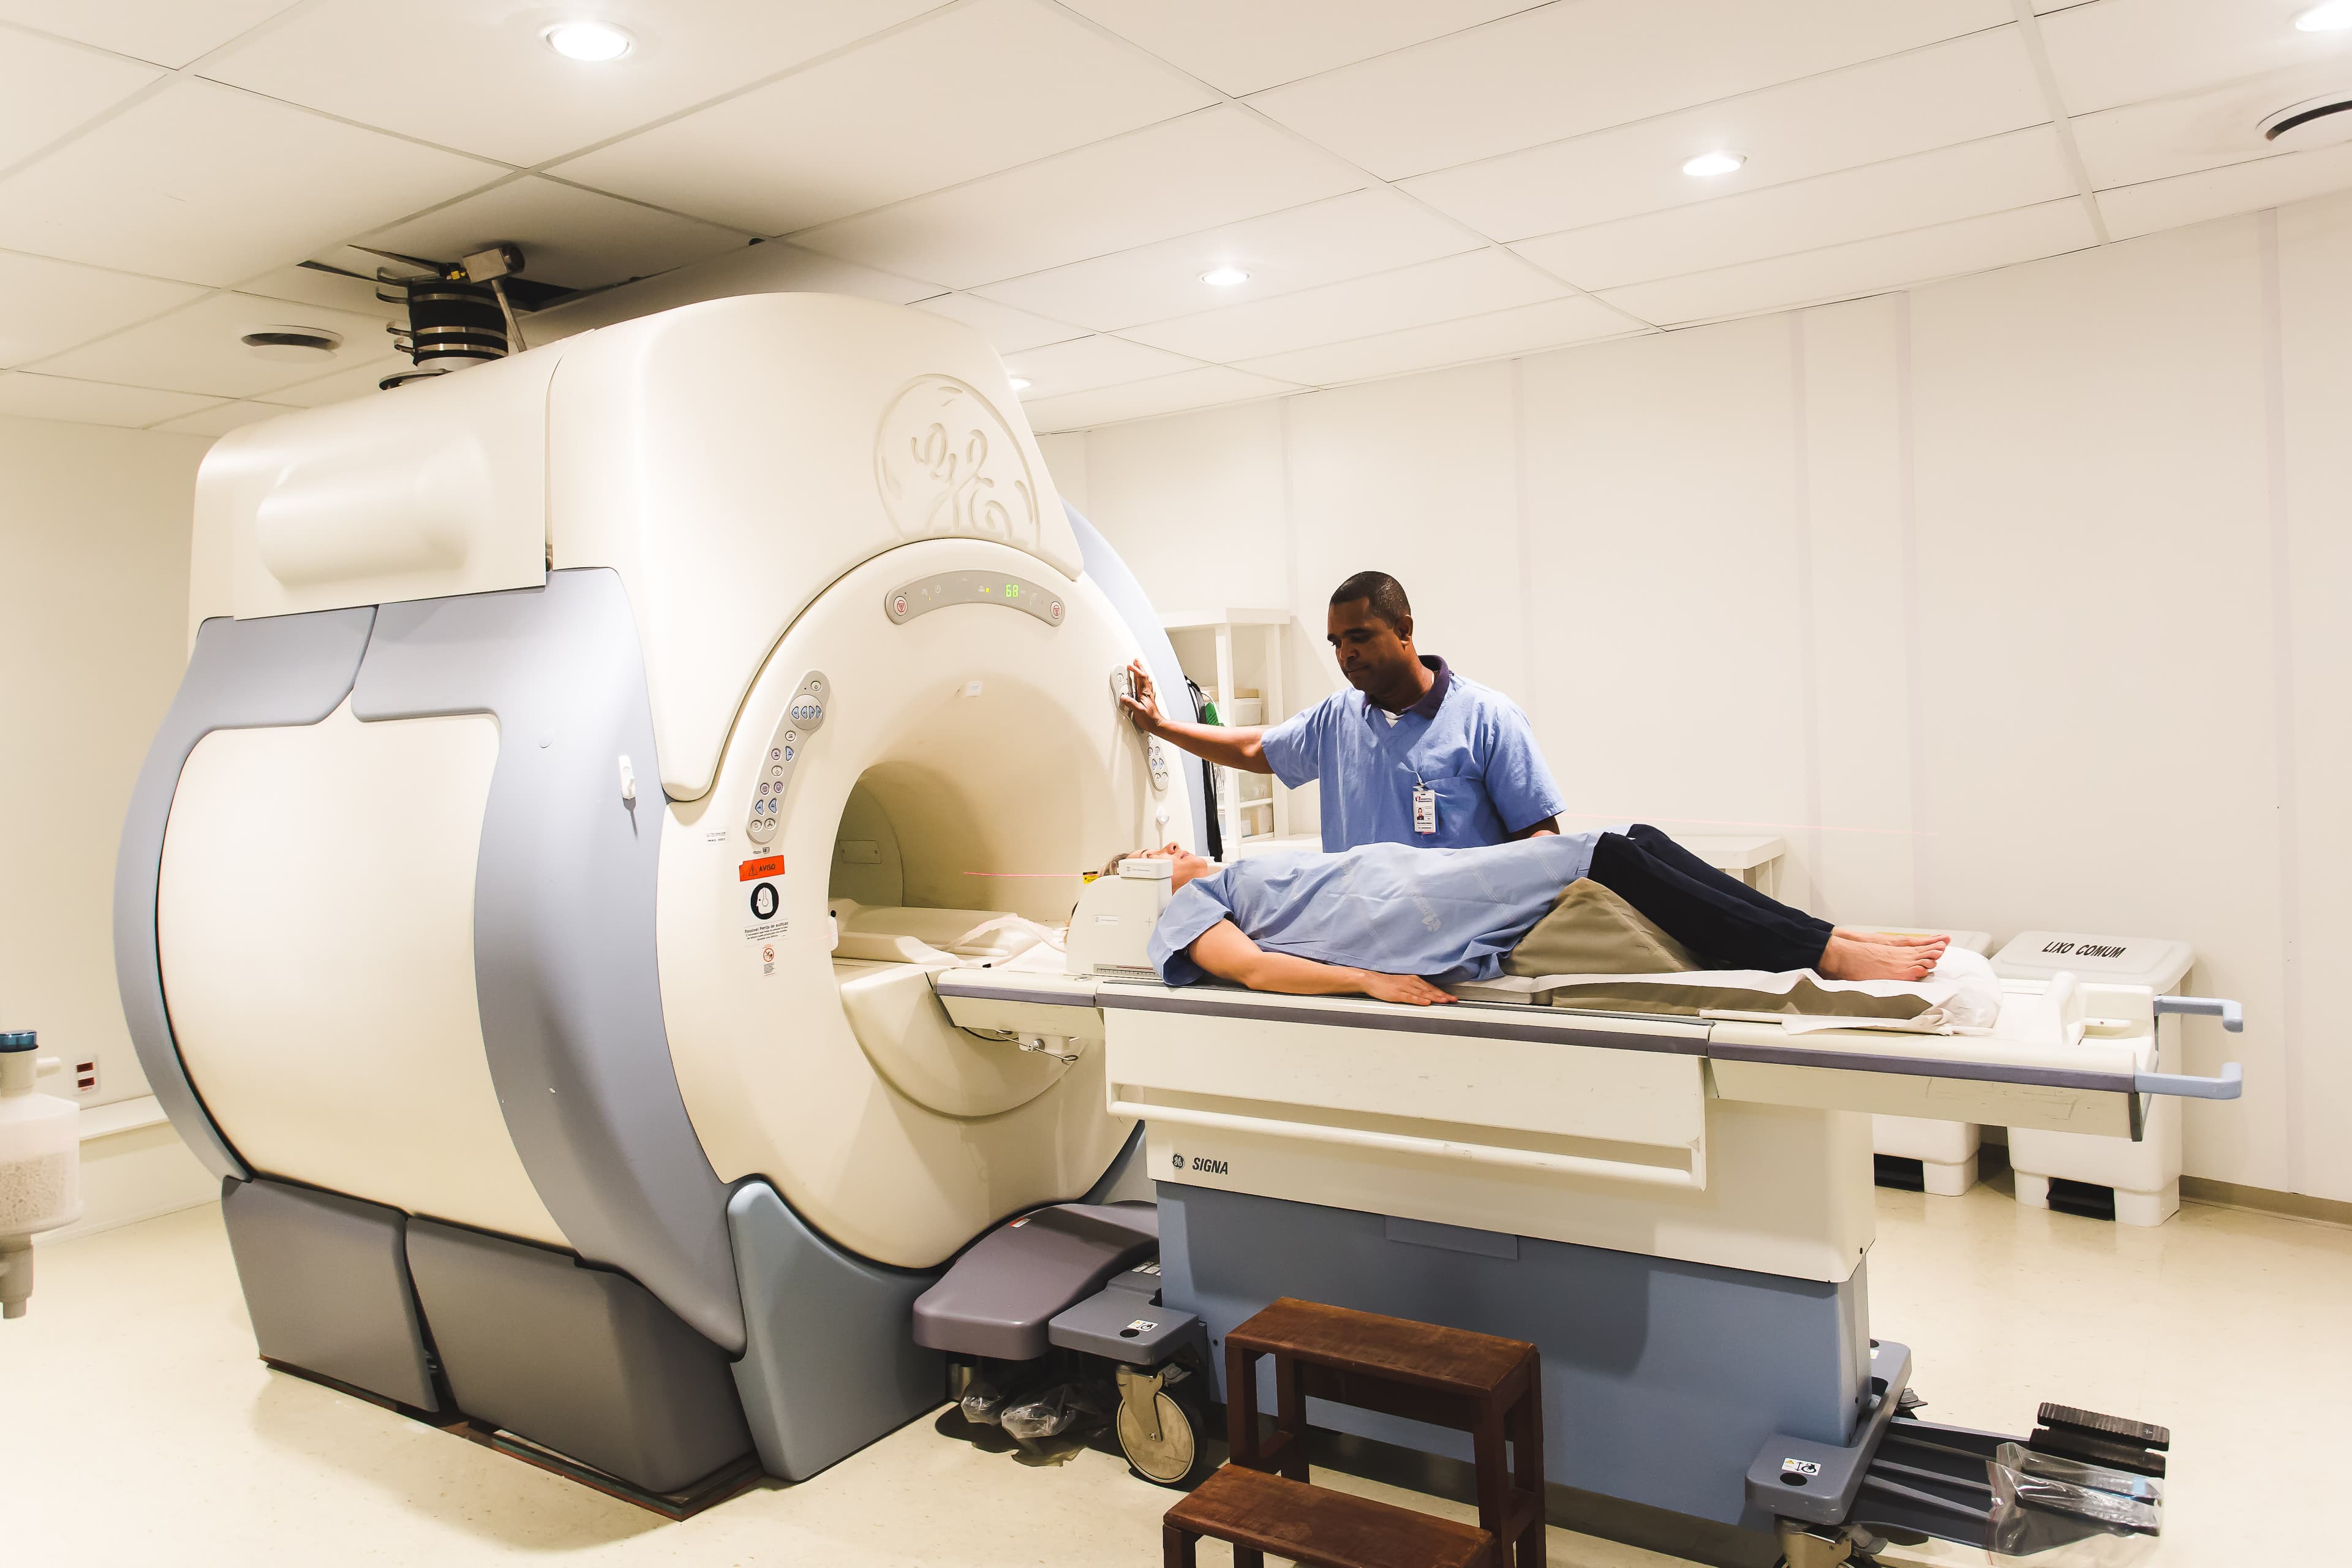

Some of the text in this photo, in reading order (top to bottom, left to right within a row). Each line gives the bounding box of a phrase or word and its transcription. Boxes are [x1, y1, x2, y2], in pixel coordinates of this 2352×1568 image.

[2041, 941, 2127, 958] LIXO COMUM
[1193, 1157, 1228, 1175] SIGNA
